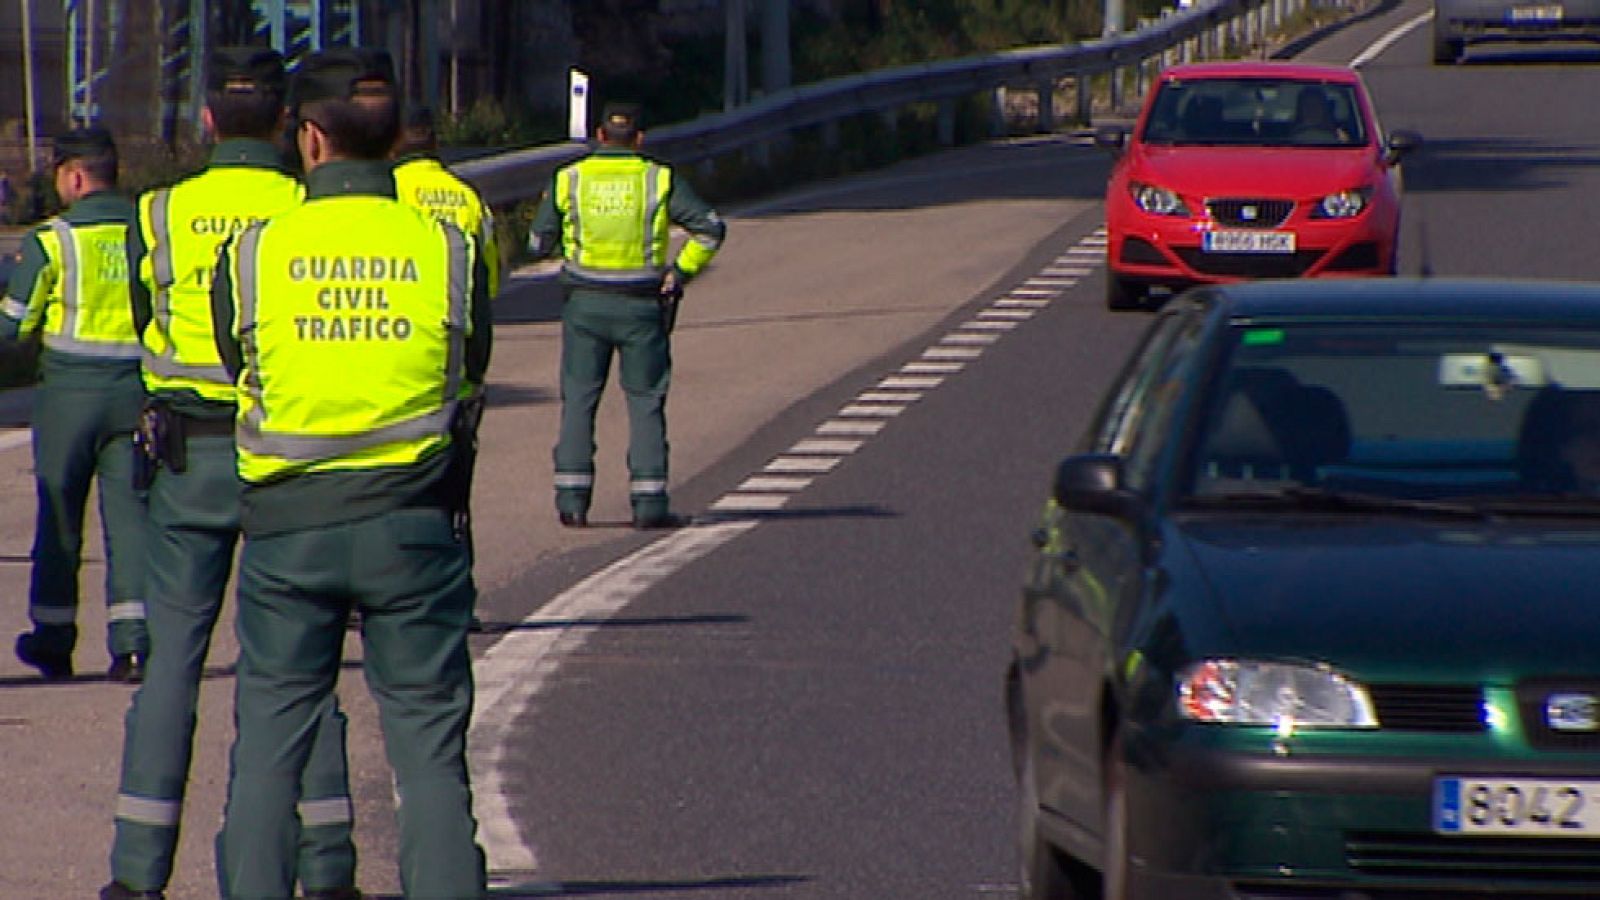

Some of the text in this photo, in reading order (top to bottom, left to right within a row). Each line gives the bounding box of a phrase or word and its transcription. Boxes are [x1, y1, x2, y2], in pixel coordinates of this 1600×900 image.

[288, 256, 419, 282] GUARDIA
[317, 286, 390, 310] CIVIL
[294, 316, 412, 341] TRAFICO
[1468, 784, 1586, 828] 8042
